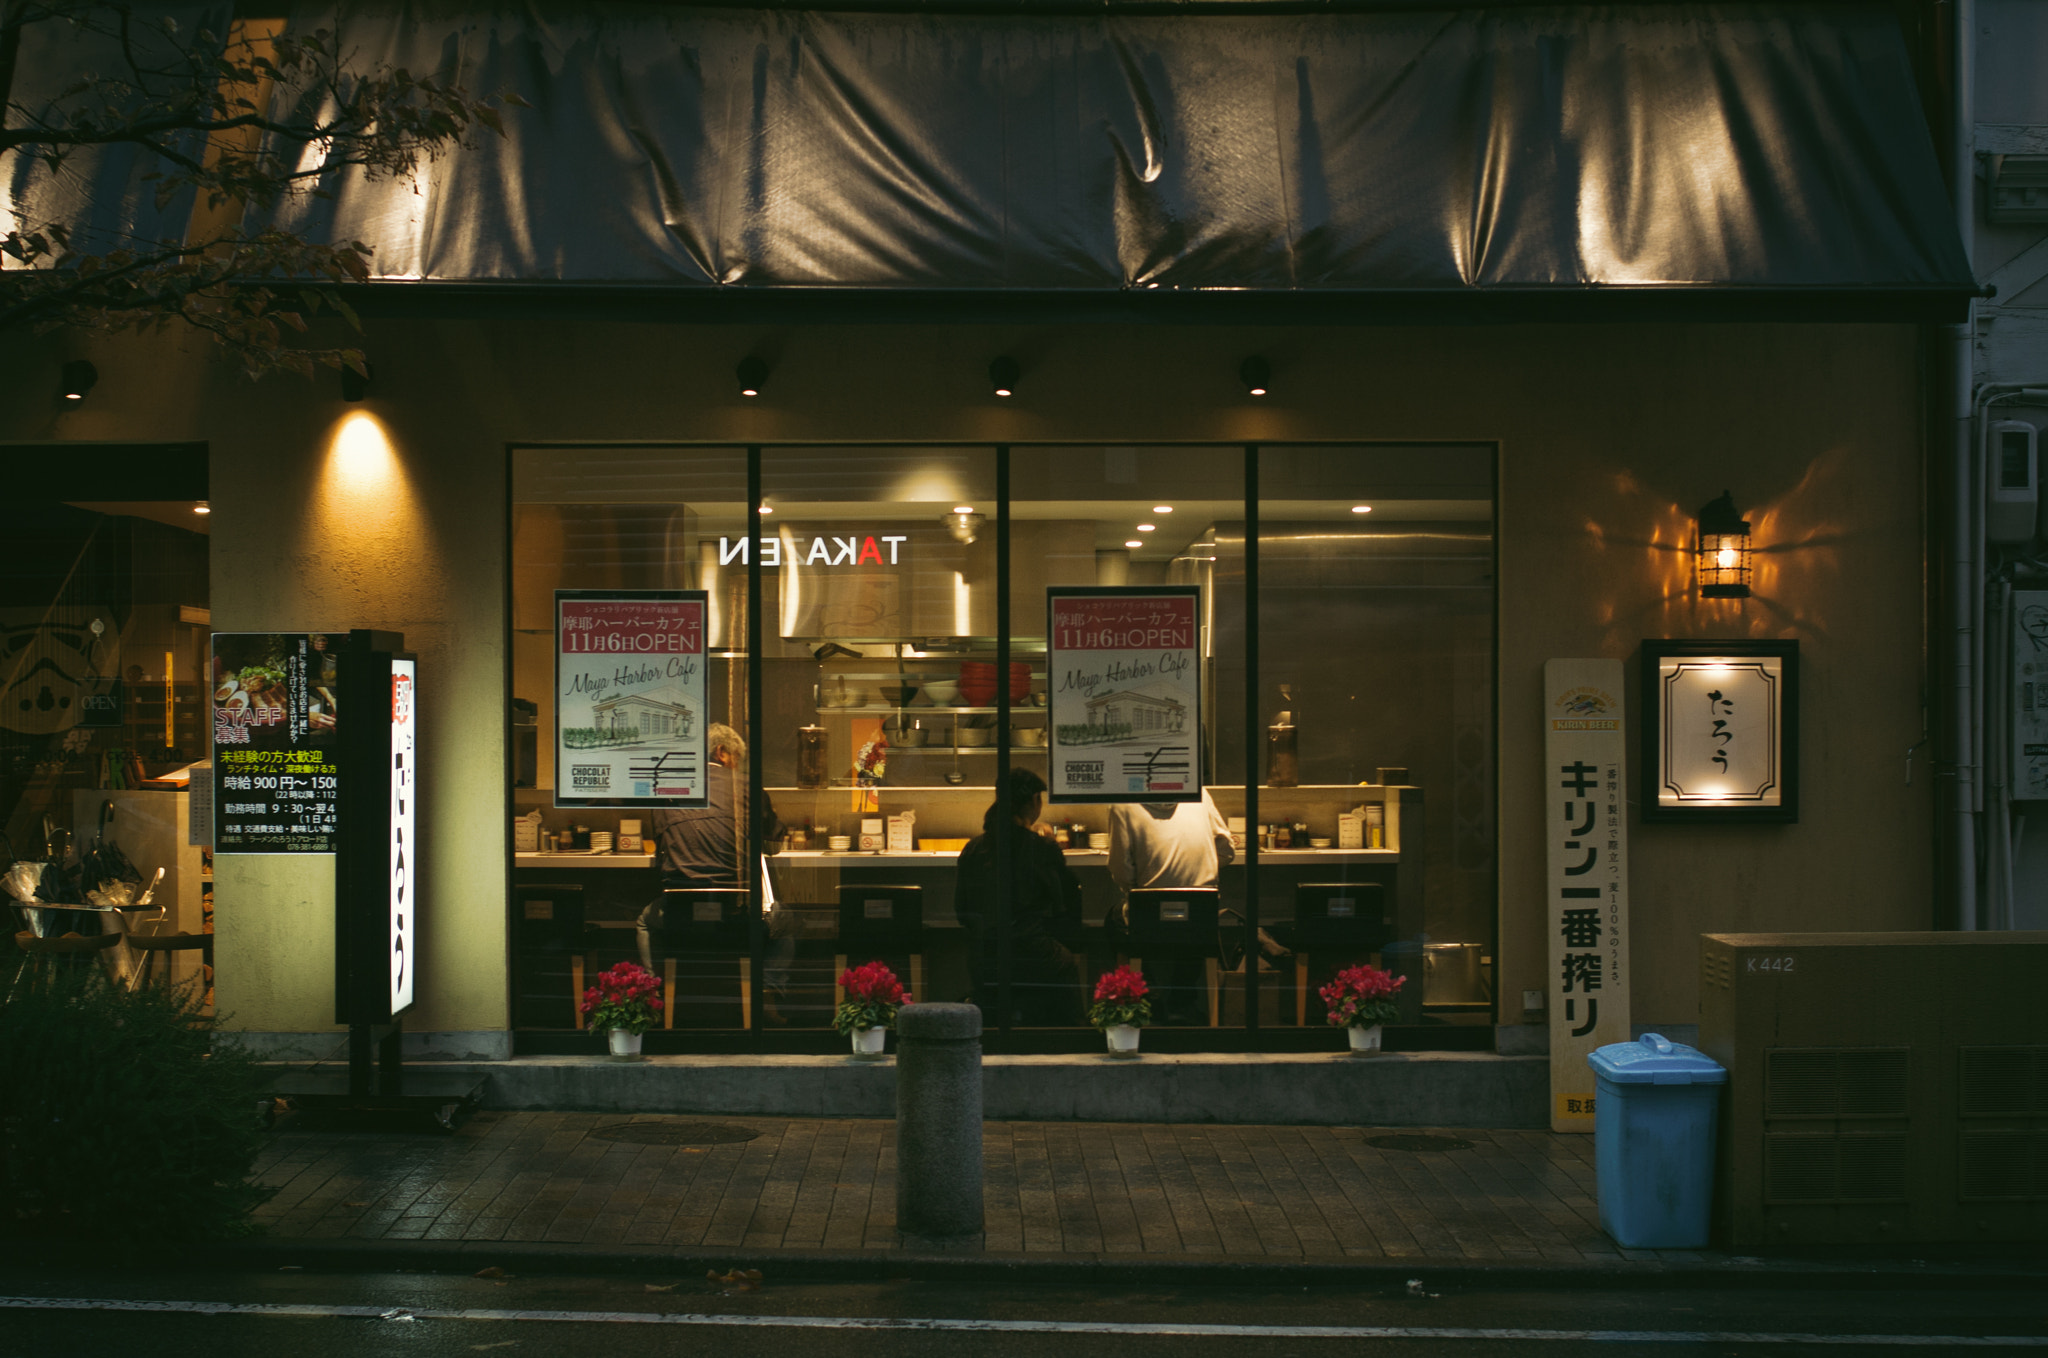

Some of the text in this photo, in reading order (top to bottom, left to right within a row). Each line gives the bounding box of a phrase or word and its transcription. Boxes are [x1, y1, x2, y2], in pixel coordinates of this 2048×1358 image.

[563, 616, 700, 631] 摩耶ハーバーカフェ
[1055, 613, 1192, 628] 摩耶ハーバーカフェ
[565, 656, 697, 701] Maya Harbor Cafe
[1058, 651, 1189, 697] Maya Harbor Cafe
[81, 696, 117, 710] OPEN
[214, 707, 282, 726] STAFF
[1557, 720, 1615, 729] KIRIN BEER
[214, 725, 251, 744] 募集
[1707, 690, 1734, 774] たろう
[220, 750, 323, 764] 未経験の方大歓迎
[572, 768, 611, 776] CHOCOLAT
[1065, 764, 1104, 772] CHOCOLAT
[573, 777, 610, 785] REPUBLIC
[1066, 773, 1104, 781] REPUBLIC
[224, 803, 266, 814] 勤務時間
[1560, 761, 1602, 1037] キリン一番搾り
